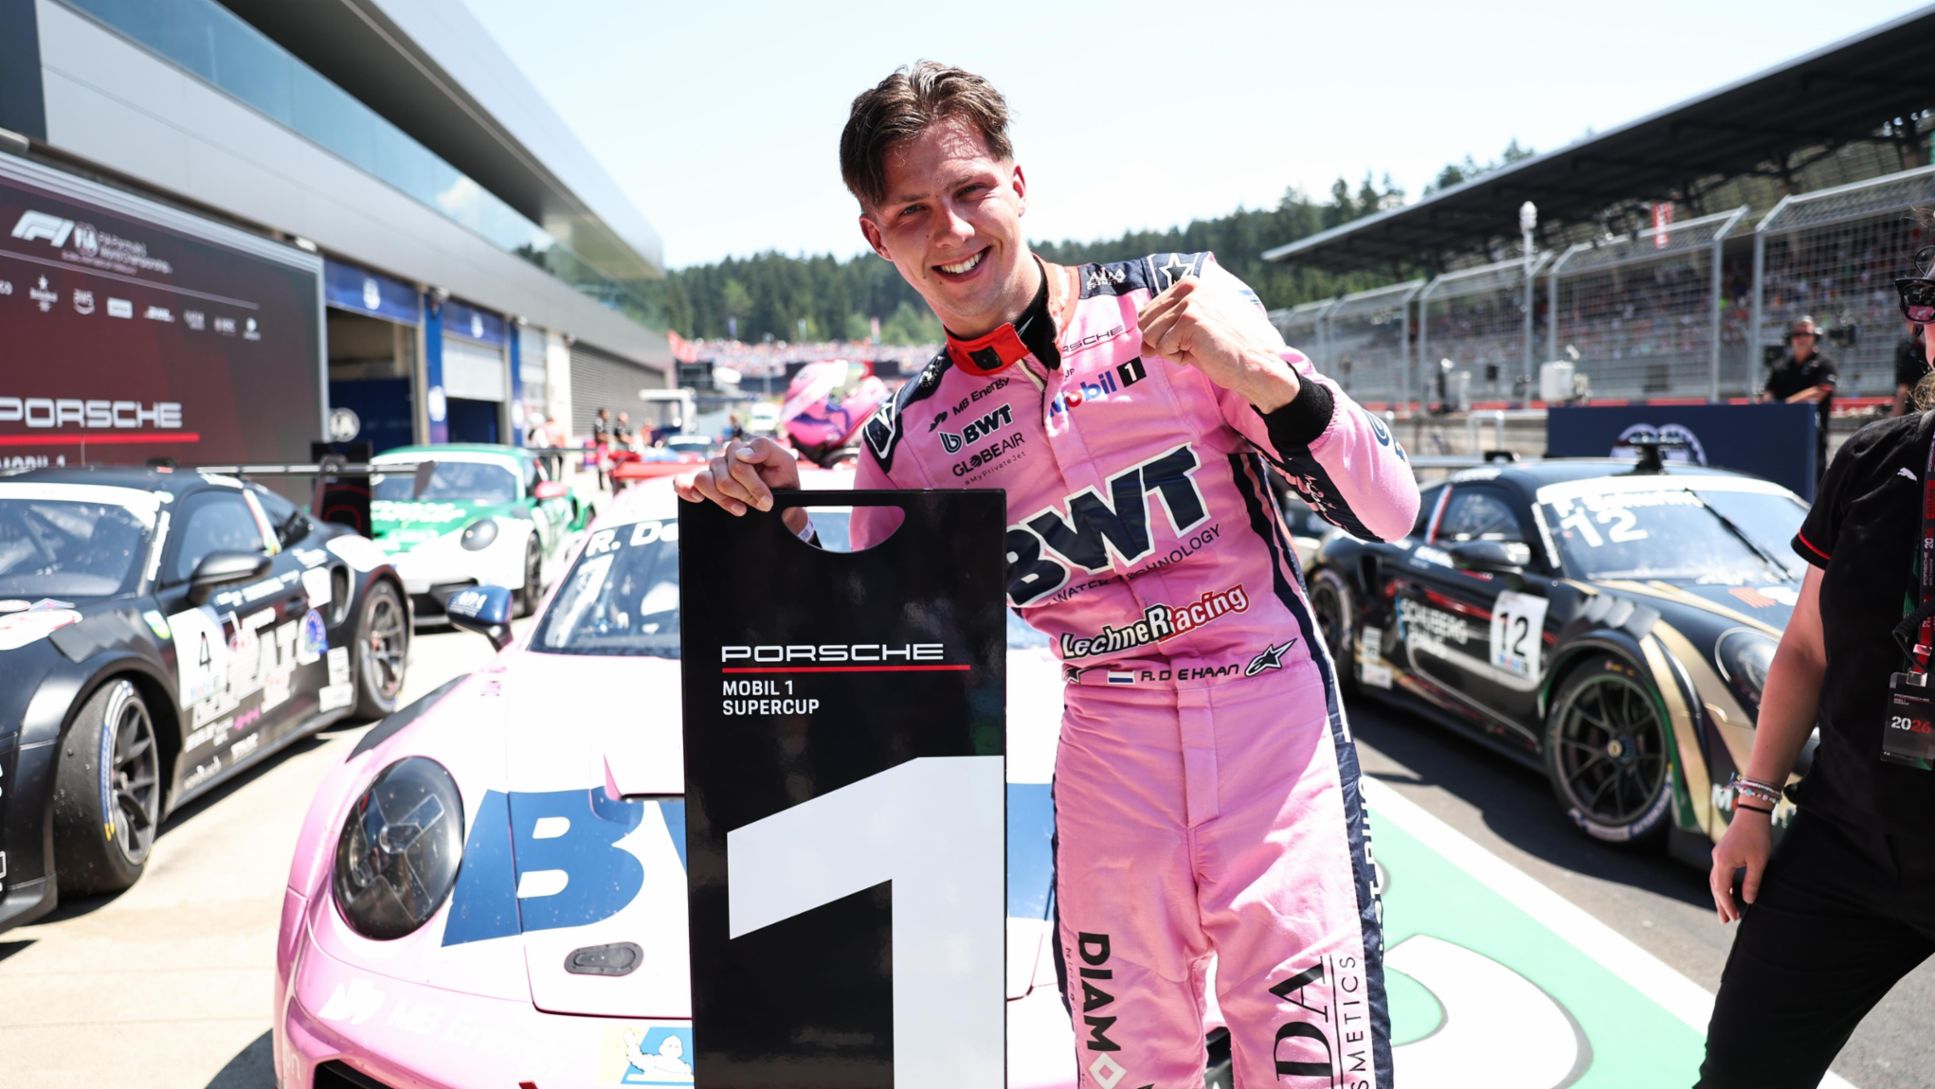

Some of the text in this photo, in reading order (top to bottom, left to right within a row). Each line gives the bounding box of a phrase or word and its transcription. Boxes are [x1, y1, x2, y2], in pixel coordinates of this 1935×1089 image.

[0, 397, 183, 429] PORSCHE
[952, 397, 970, 416] MB
[962, 402, 1014, 446] BWT
[952, 431, 1026, 477] GLOBEAIR
[585, 529, 621, 557] R.
[1006, 441, 1212, 609] BWT
[1560, 509, 1649, 547] 12
[198, 630, 212, 672] 4
[721, 643, 944, 662] PORSCHE
[1500, 612, 1530, 657] 12
[722, 680, 794, 696] MOBIL 1
[722, 699, 820, 716] SUPERCUP
[727, 755, 1005, 1089] 1
